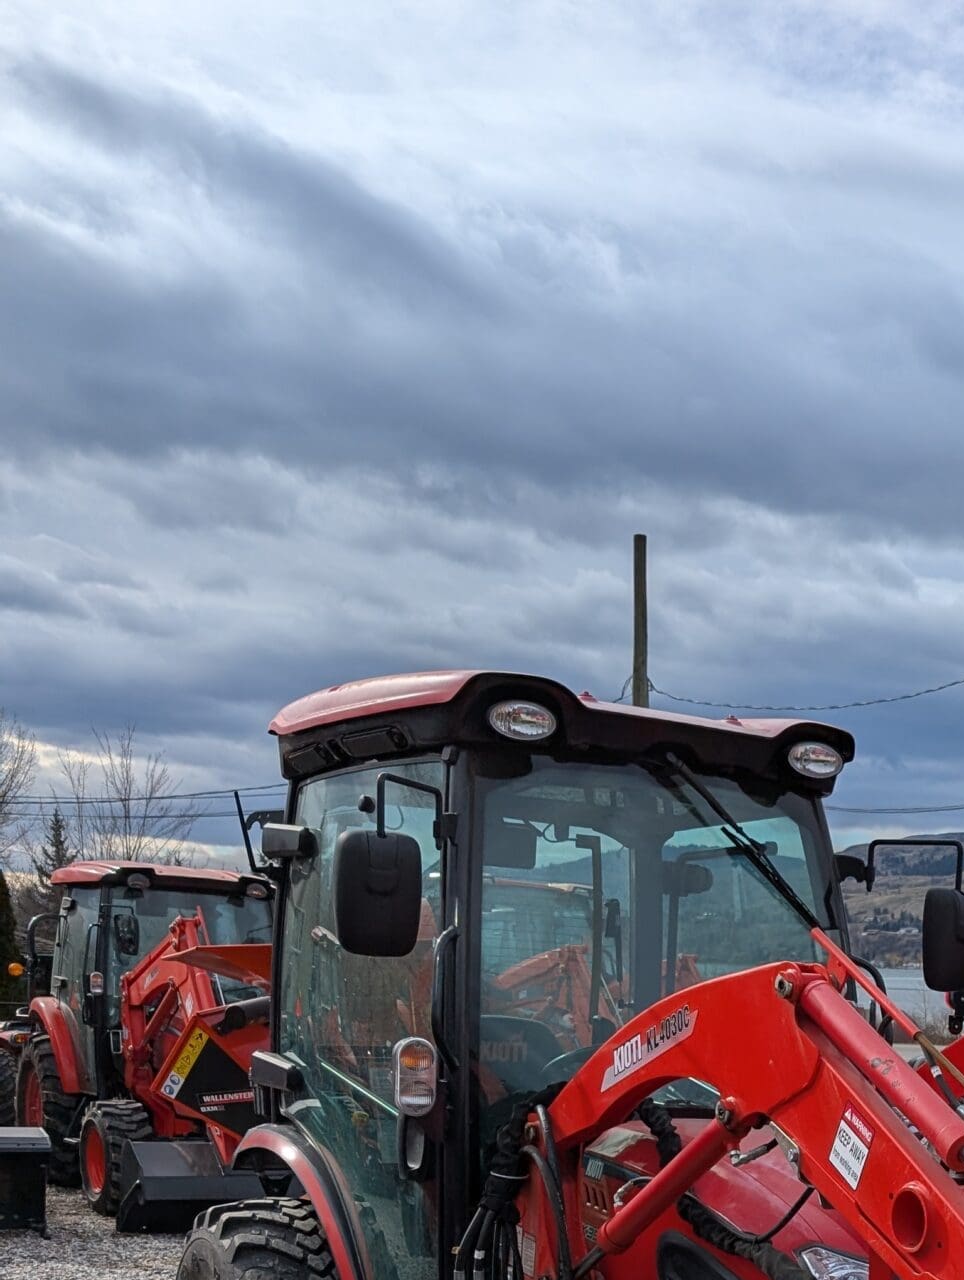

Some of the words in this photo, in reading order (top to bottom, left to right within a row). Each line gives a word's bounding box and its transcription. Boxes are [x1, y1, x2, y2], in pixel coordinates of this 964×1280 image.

[614, 1033, 642, 1076] KIOTI
[646, 1005, 690, 1053] KL4030C
[838, 1127, 851, 1149] KEEP
[848, 1140, 865, 1166] AWAY
